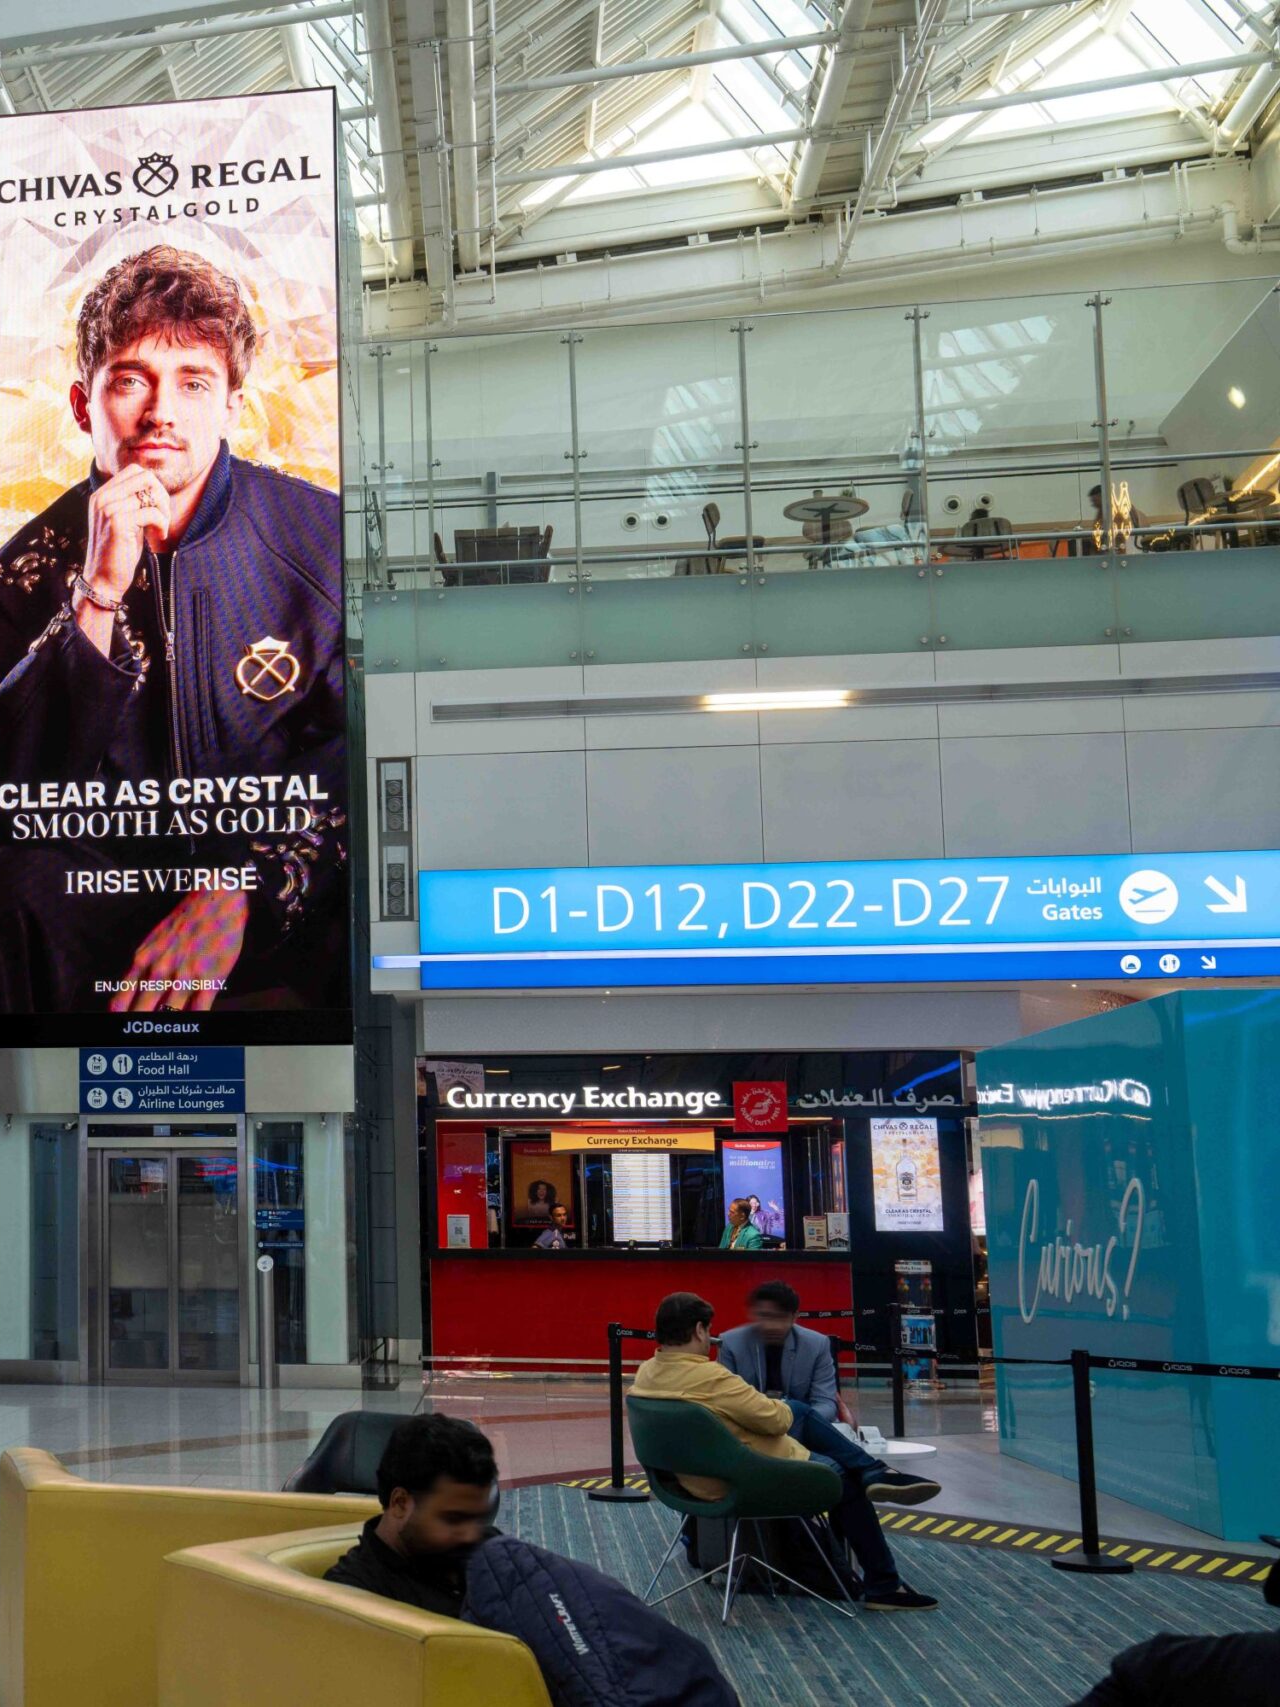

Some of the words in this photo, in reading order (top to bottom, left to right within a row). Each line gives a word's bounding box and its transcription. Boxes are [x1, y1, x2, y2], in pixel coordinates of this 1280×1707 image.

[190, 155, 321, 189] REGAL
[114, 779, 159, 806] AS
[168, 775, 329, 804] CRYSTAL
[12, 810, 157, 840] SMOOTH
[165, 809, 208, 836] AS
[216, 806, 311, 834] GOLD
[1026, 877, 1102, 897] البوابات
[1042, 904, 1103, 921] Gates
[95, 980, 137, 993] ENJOY
[139, 979, 228, 993] RESPONSIBLY.
[122, 1021, 200, 1034] JCDecaux
[137, 1052, 174, 1064] المطاعم
[176, 1053, 198, 1063] ردهة
[138, 1065, 165, 1075] Food
[168, 1065, 190, 1075] Hall
[138, 1085, 169, 1096] الطيران
[172, 1085, 202, 1095] شركات
[204, 1085, 236, 1095] صالات
[138, 1099, 175, 1109] Airline
[178, 1099, 225, 1110] Lounges
[446, 1087, 576, 1113] Currency
[582, 1086, 721, 1114] Exchange
[797, 1088, 883, 1109] العملات
[894, 1088, 956, 1113] صرف
[586, 1136, 630, 1146] Currency
[632, 1135, 679, 1146] Exchange
[1017, 1177, 1145, 1324] Curious?
